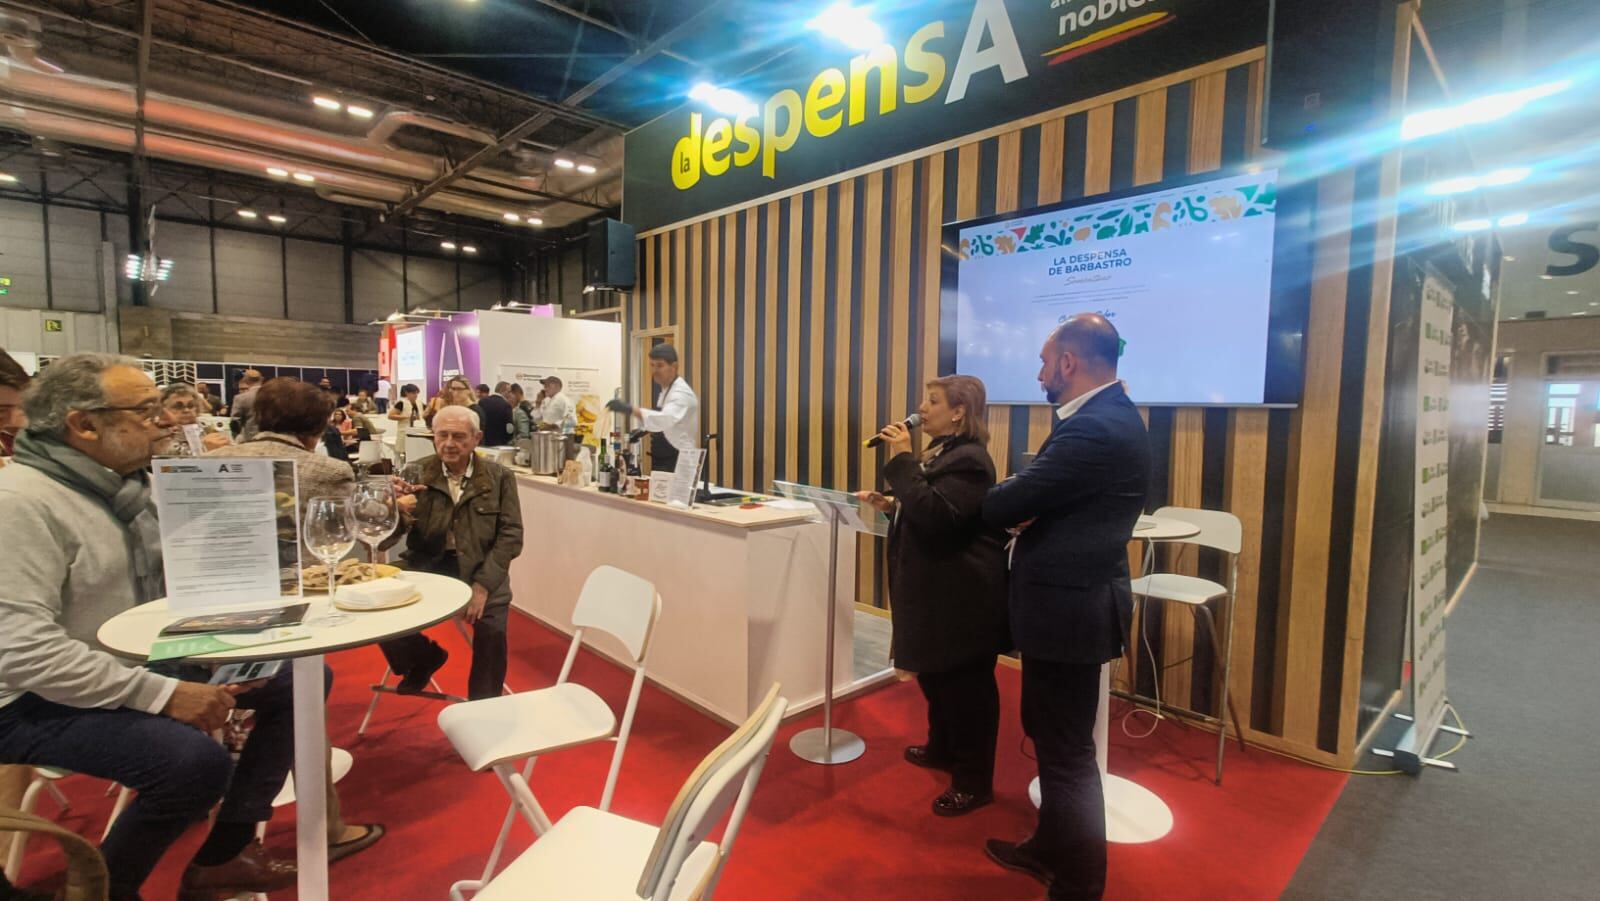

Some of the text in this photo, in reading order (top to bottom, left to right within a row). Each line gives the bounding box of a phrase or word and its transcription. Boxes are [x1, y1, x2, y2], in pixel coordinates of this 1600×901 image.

[671, 0, 1029, 190] la despensA
[1048, 257, 1132, 276] DE BARBASTRO
[1053, 248, 1127, 266] LA DESPENSA
